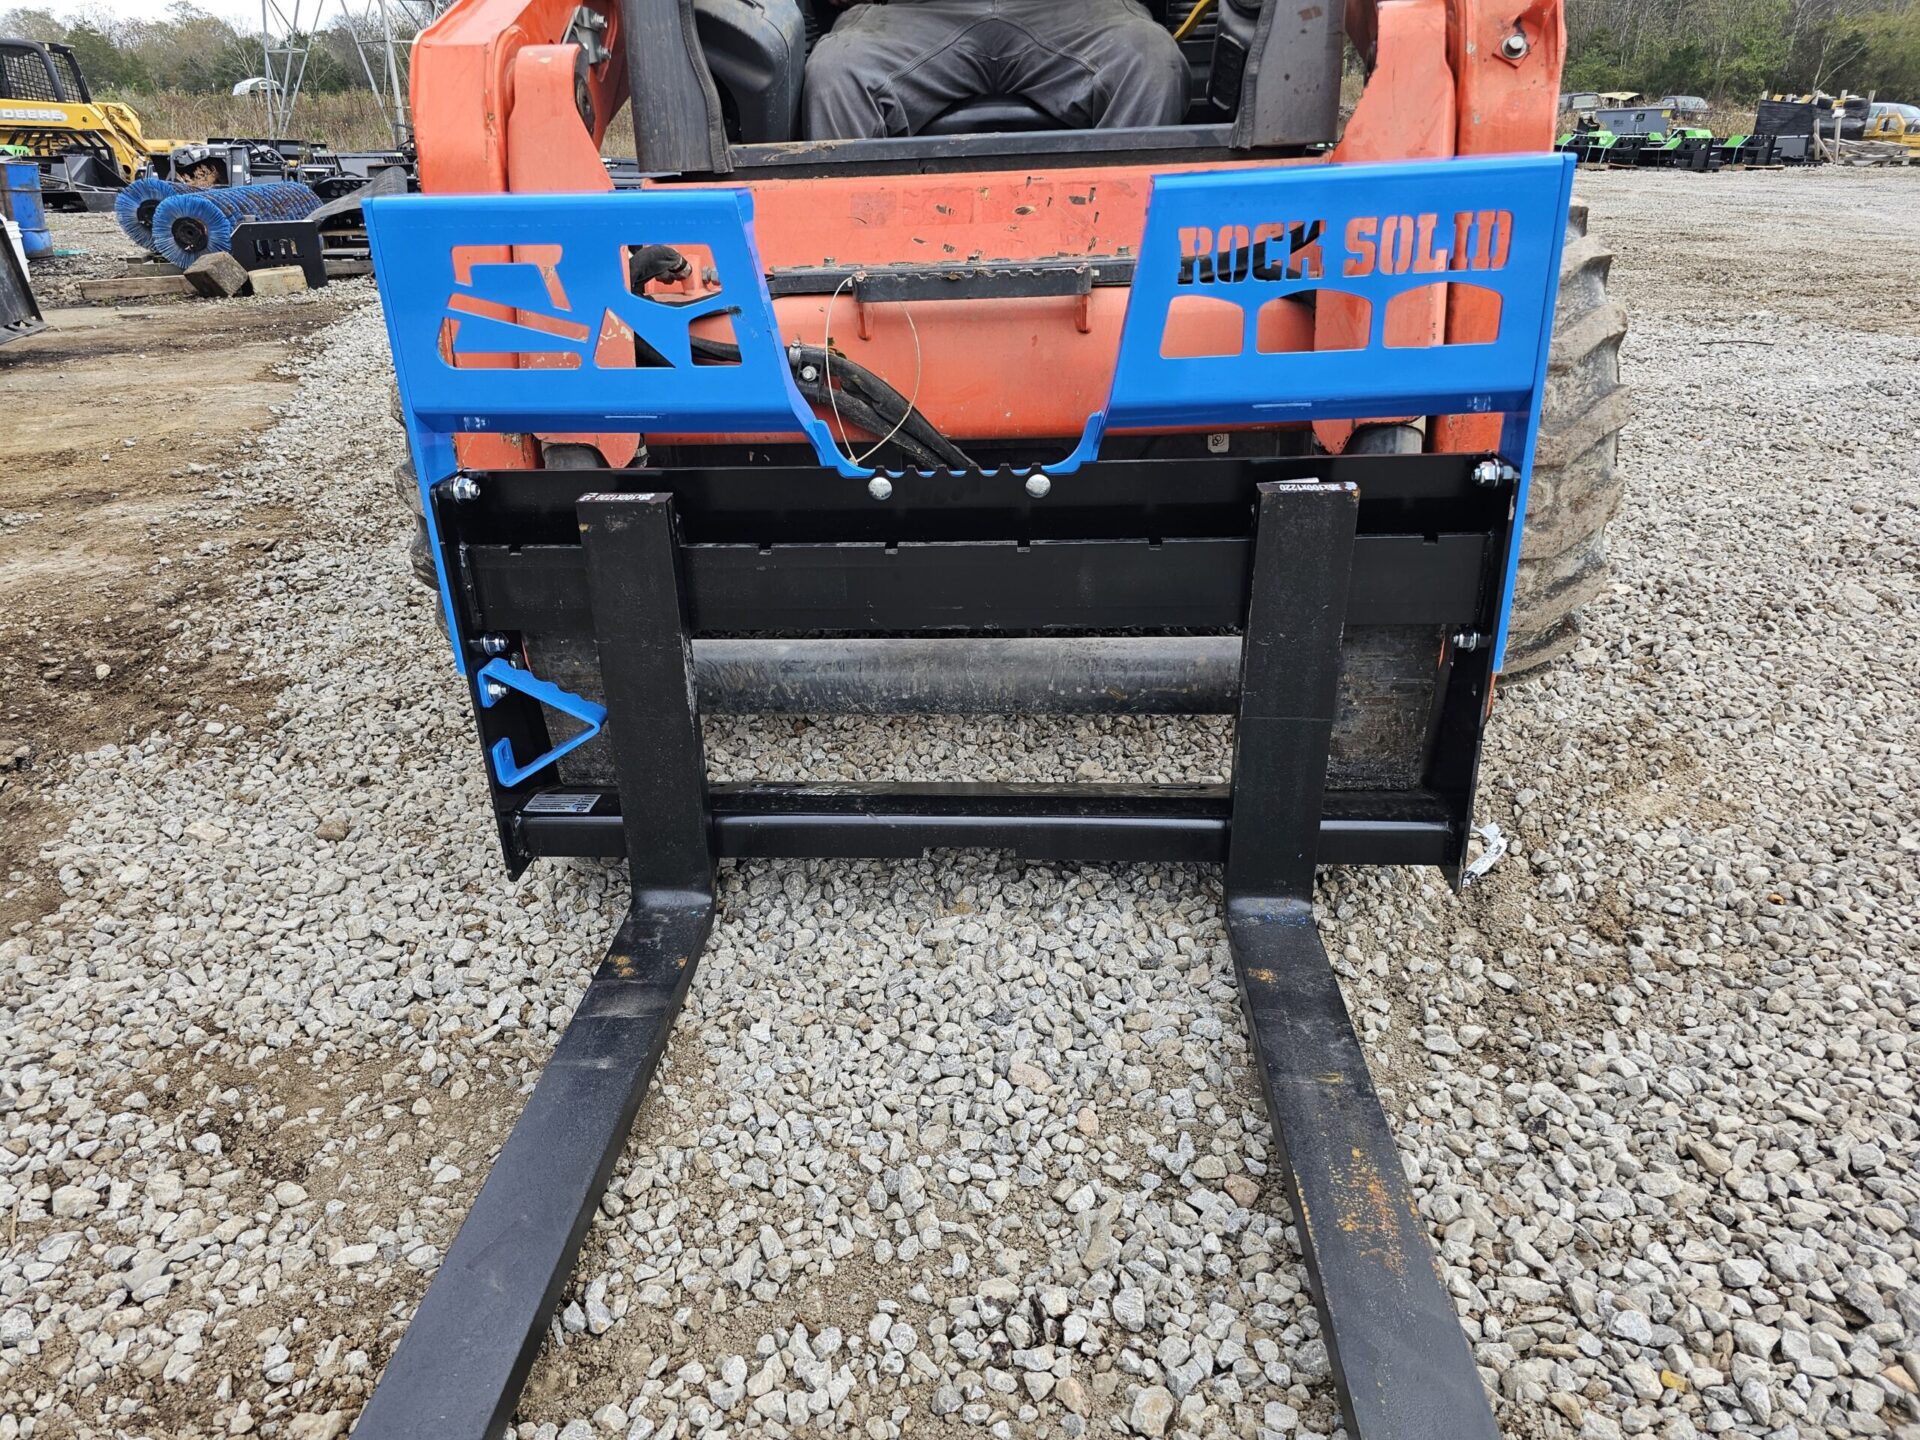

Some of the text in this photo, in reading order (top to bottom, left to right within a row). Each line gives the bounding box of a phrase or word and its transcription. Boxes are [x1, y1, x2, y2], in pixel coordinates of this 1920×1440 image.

[2, 108, 63, 120] DEERE
[1177, 208, 1515, 286] ROCK SOLID
